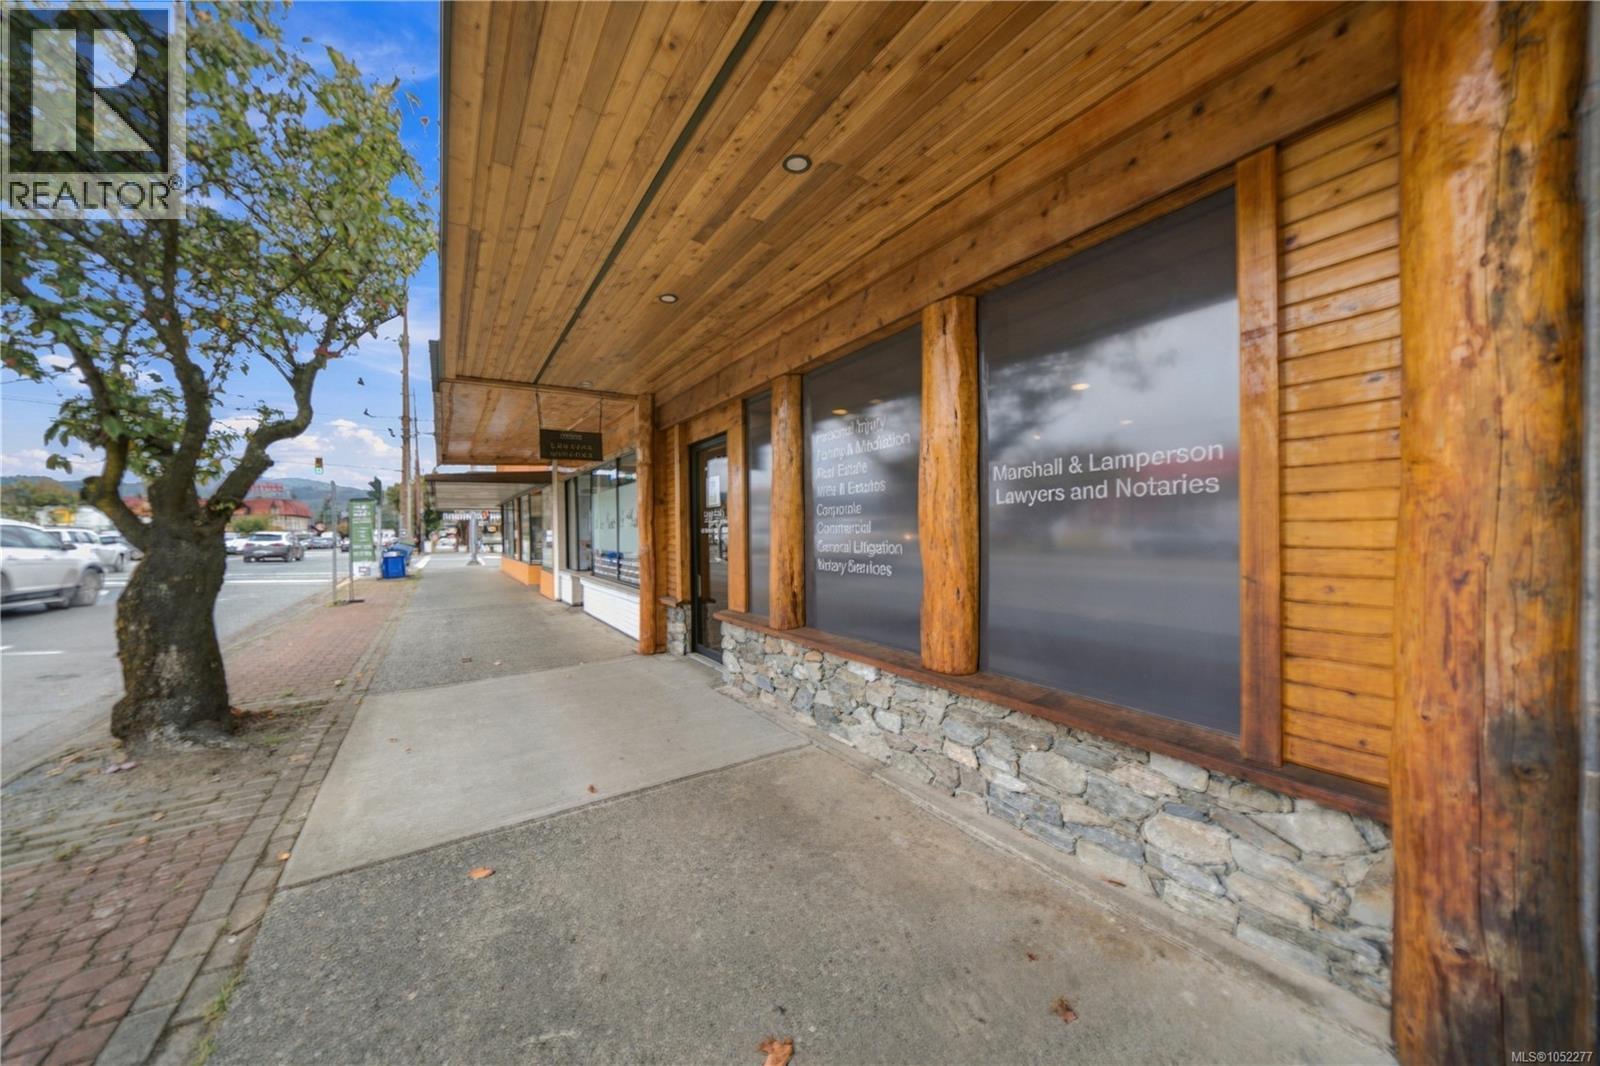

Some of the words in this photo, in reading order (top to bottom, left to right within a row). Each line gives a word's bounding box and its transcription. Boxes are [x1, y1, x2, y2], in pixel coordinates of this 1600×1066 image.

[992, 456, 1063, 482] Marshall
[1069, 455, 1082, 474] &
[1089, 442, 1224, 473] Lamperson
[995, 486, 1065, 507] Lawyers
[1070, 480, 1108, 500] and
[1116, 474, 1220, 499] Notaries
[816, 520, 872, 535] Commercial
[853, 539, 903, 557] Litigation
